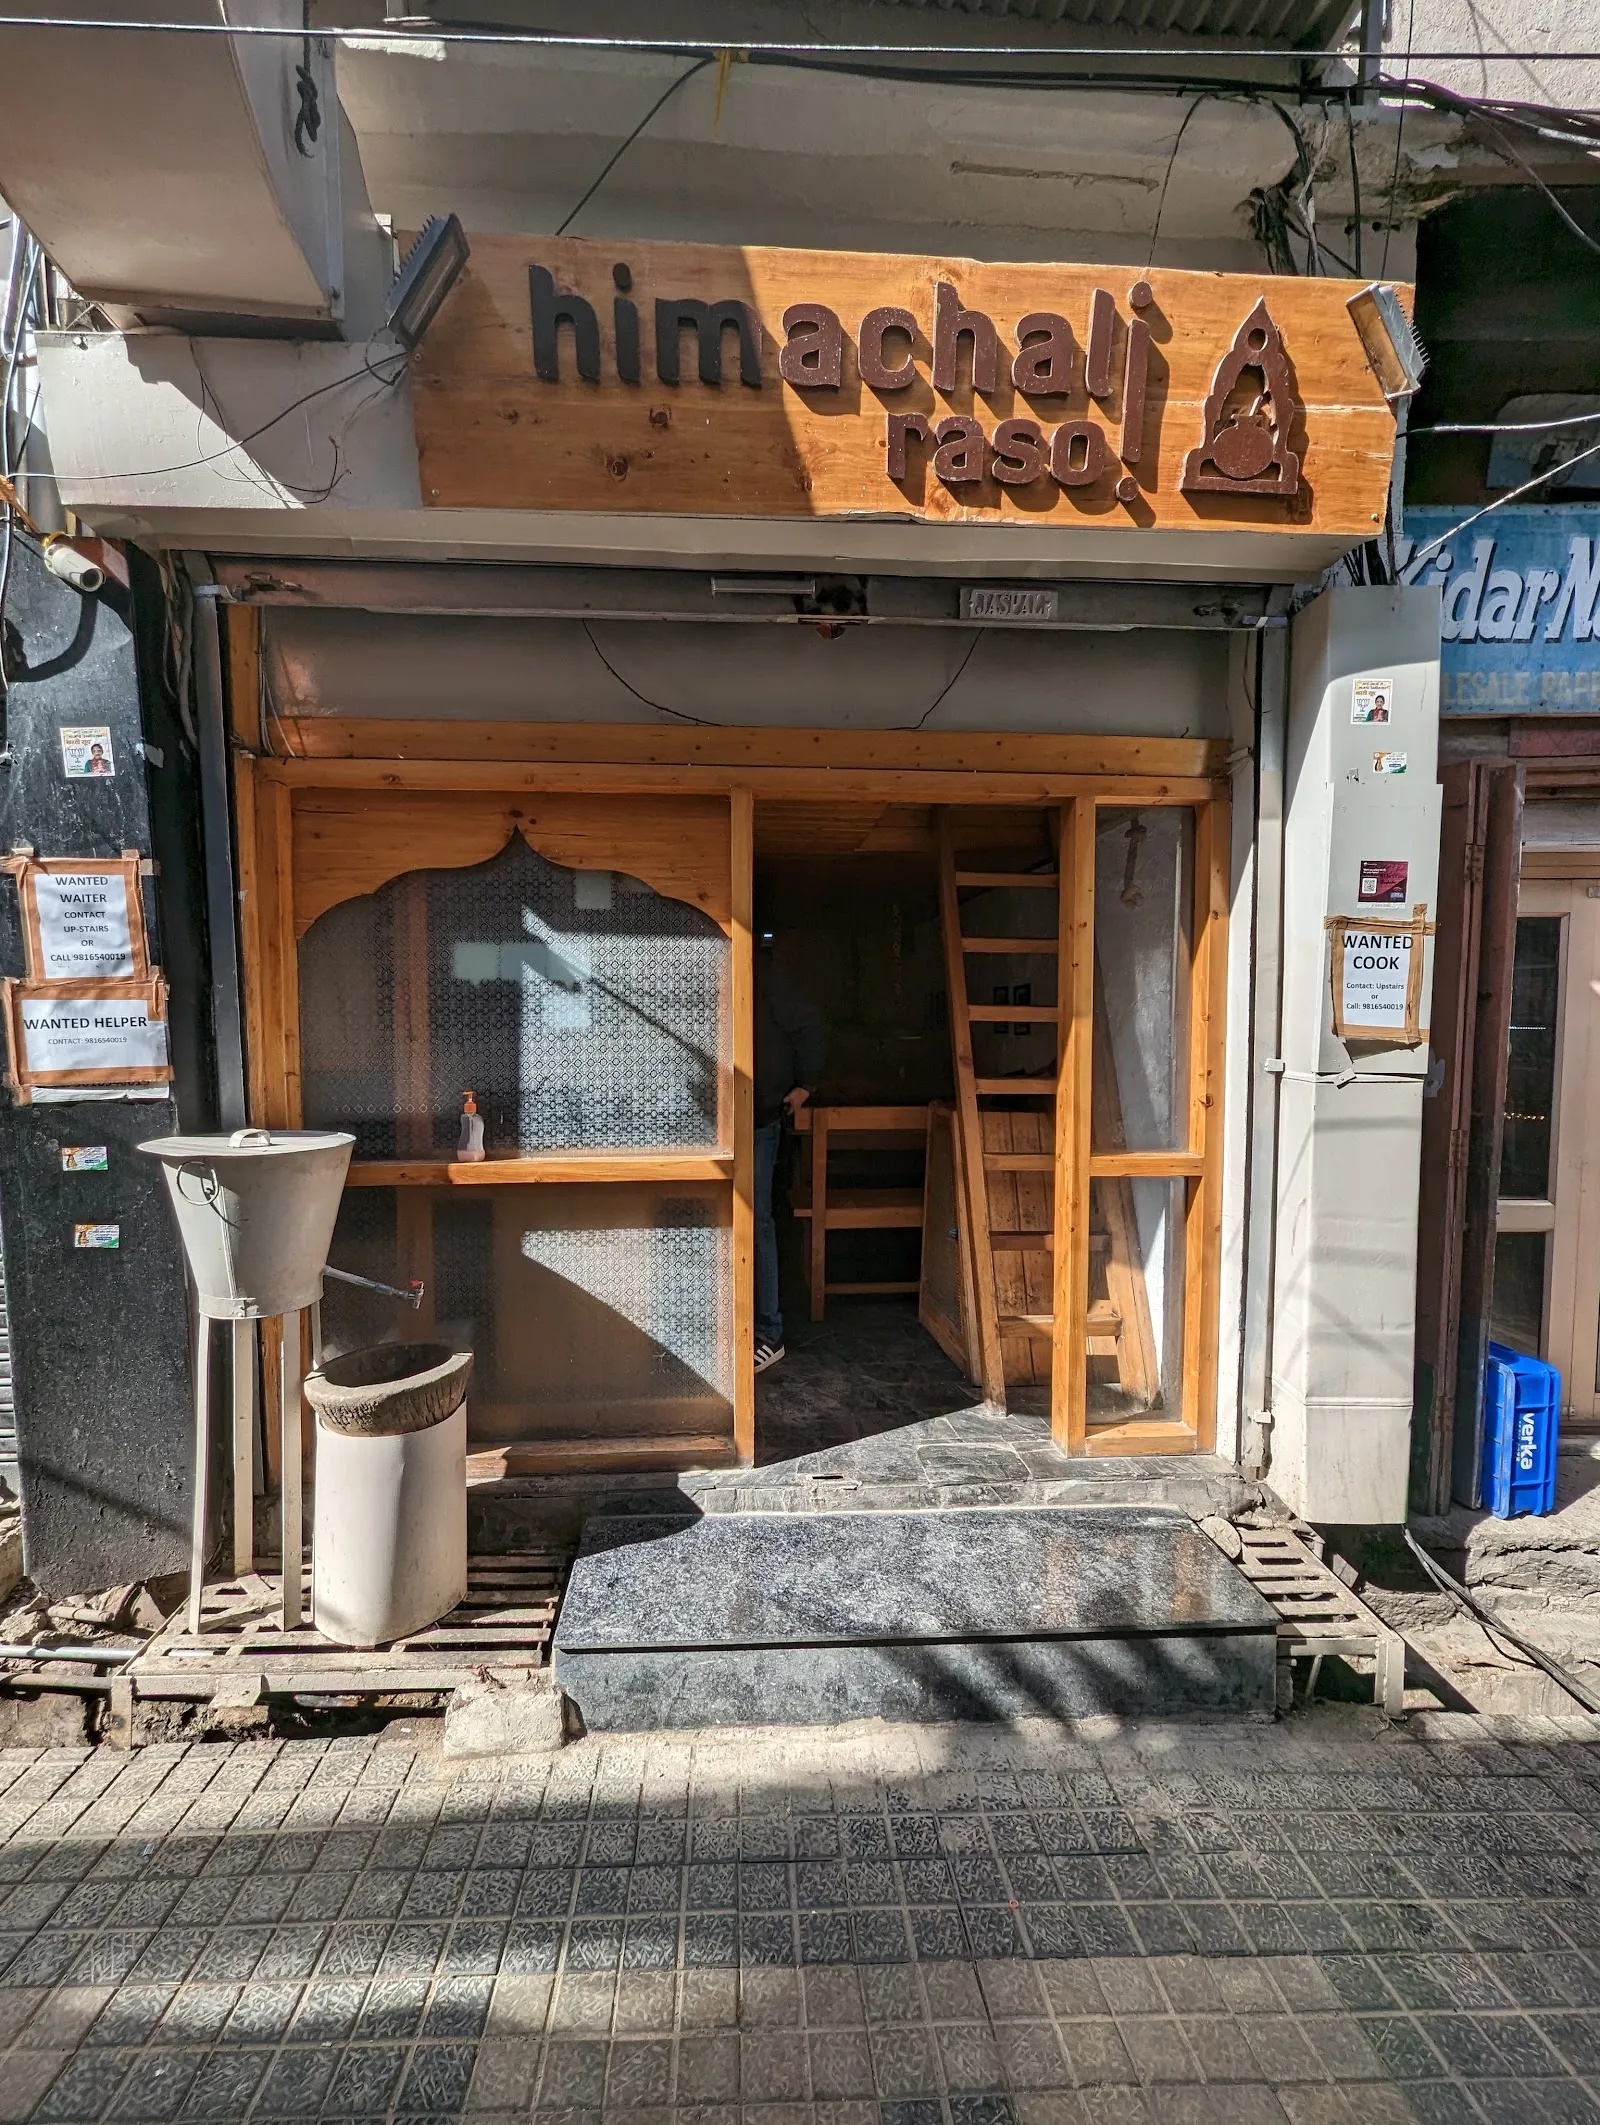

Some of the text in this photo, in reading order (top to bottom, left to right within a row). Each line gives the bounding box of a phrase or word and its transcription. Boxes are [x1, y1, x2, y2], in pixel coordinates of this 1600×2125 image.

[529, 262, 1153, 462] himachali
[1543, 536, 1600, 643] N
[974, 592, 1046, 616] JASPAL
[55, 876, 109, 886] WANTED
[60, 893, 107, 903] WAITER
[64, 911, 106, 919] CONTACT
[63, 925, 109, 933] UP-STAIRS
[81, 939, 94, 947] OR
[1341, 935, 1414, 949] WANTED
[50, 953, 126, 962] CALL 9816540019
[1353, 956, 1400, 970] COOK
[1376, 983, 1404, 991] Upstairs
[23, 1016, 148, 1030] WANTED HELPER
[84, 1036, 128, 1044] 9816540019
[1521, 1412, 1537, 1470] verka
